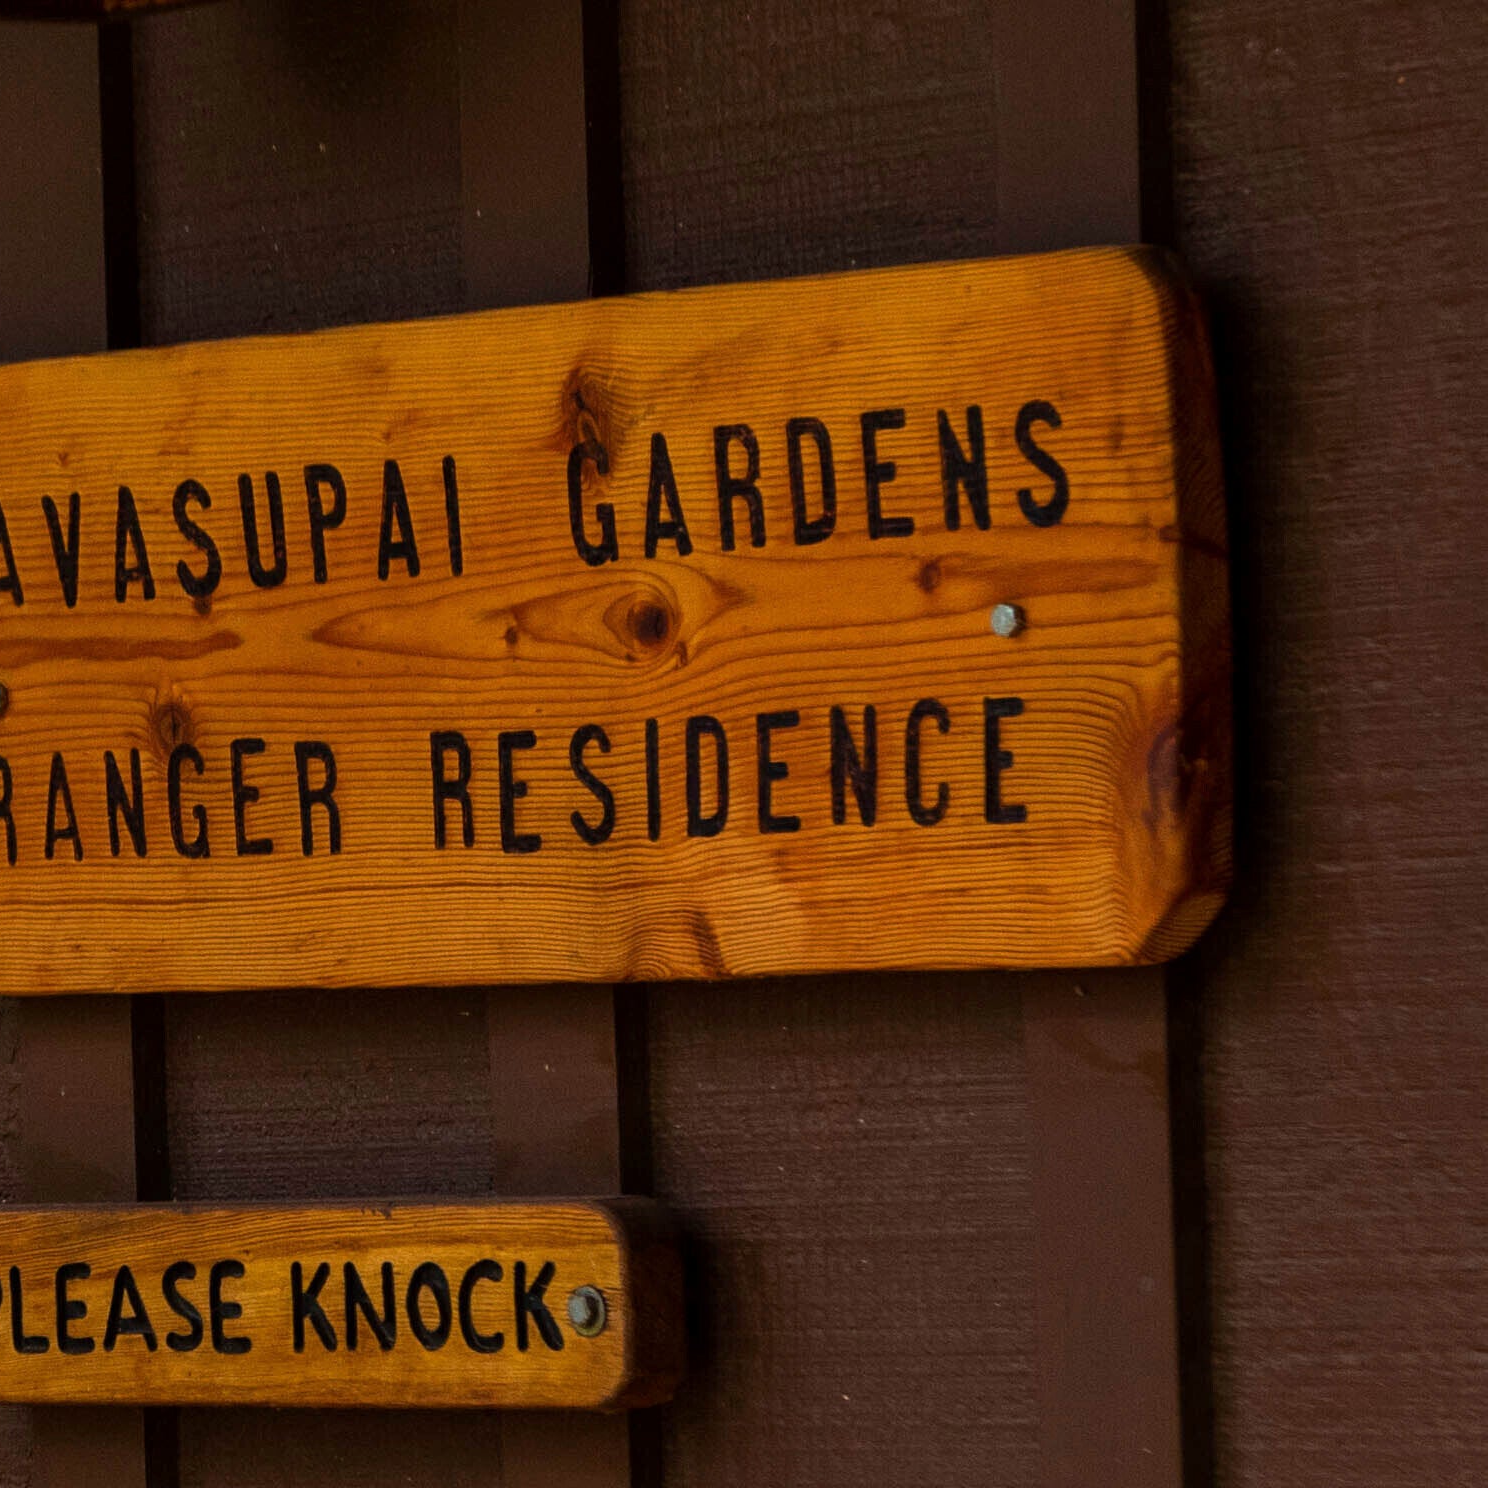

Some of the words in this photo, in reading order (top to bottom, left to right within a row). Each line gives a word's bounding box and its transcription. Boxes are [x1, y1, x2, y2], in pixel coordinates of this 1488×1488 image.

[566, 399, 1071, 568] GARDENS
[428, 695, 1030, 855] RESIDENCE
[290, 1257, 567, 1354] KNOCK
